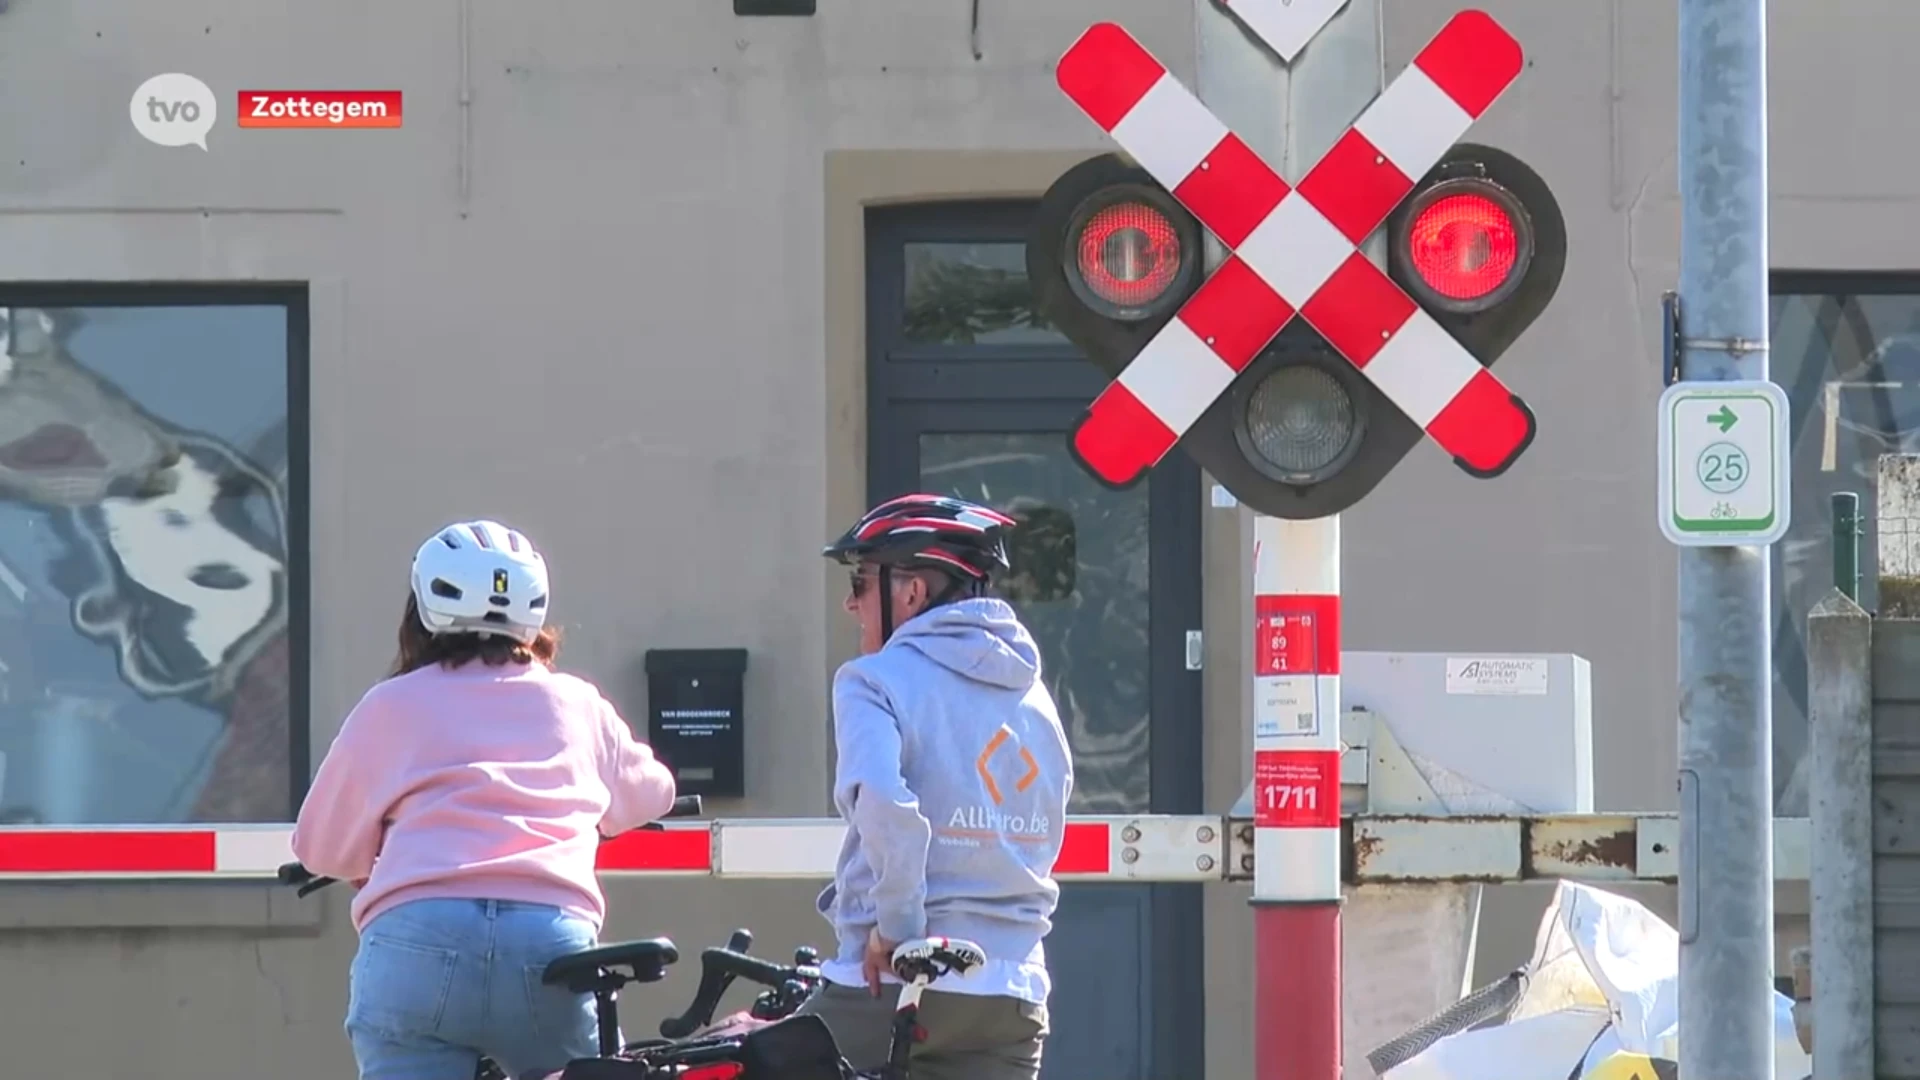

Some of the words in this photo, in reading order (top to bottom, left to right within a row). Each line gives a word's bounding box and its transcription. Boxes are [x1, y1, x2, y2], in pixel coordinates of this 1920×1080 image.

[1704, 454, 1743, 483] 25
[1271, 637, 1287, 649] 89
[1271, 659, 1288, 671] 41
[1480, 660, 1535, 671] AUTOMATIC
[1479, 671, 1518, 679] SYSTEMS
[1264, 785, 1317, 810] 1711
